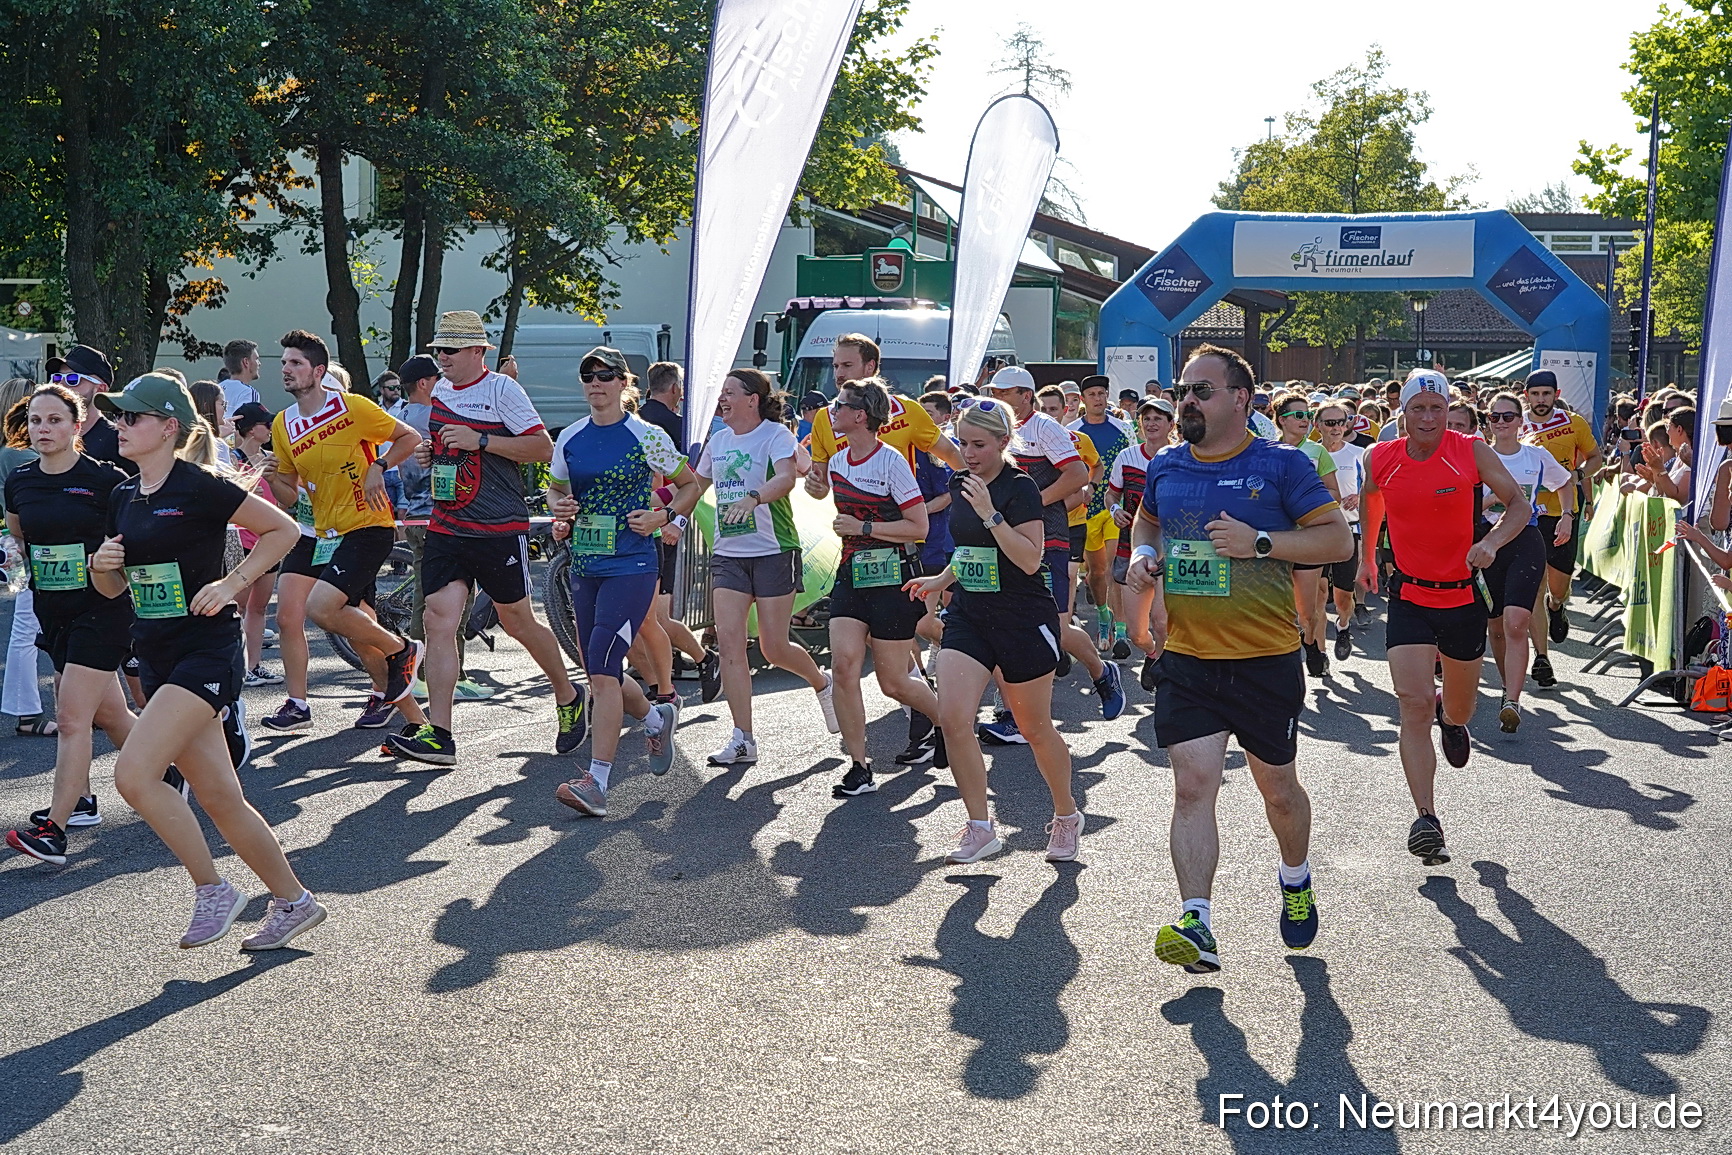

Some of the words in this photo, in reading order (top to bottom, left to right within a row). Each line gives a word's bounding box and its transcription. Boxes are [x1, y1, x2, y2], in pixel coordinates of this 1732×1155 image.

[754, 0, 812, 100] Fisch
[1348, 234, 1379, 242] Fischer
[1325, 249, 1415, 266] firmenlauf
[1153, 276, 1202, 288] Fischer
[291, 436, 317, 459] MAX
[318, 416, 355, 442] BÖGL
[1546, 427, 1574, 441] BÖGL
[580, 527, 601, 541] 711
[40, 560, 71, 576] 774
[76, 561, 85, 583] 2022
[863, 561, 888, 575] 131
[959, 561, 984, 578] 780
[989, 565, 997, 586] 2022
[1177, 558, 1212, 578] 644
[1218, 563, 1227, 589] 2022
[1173, 577, 1195, 585] Schmer
[1195, 578, 1217, 586] Daniel
[140, 582, 168, 601] 773
[172, 583, 184, 609] 2022
